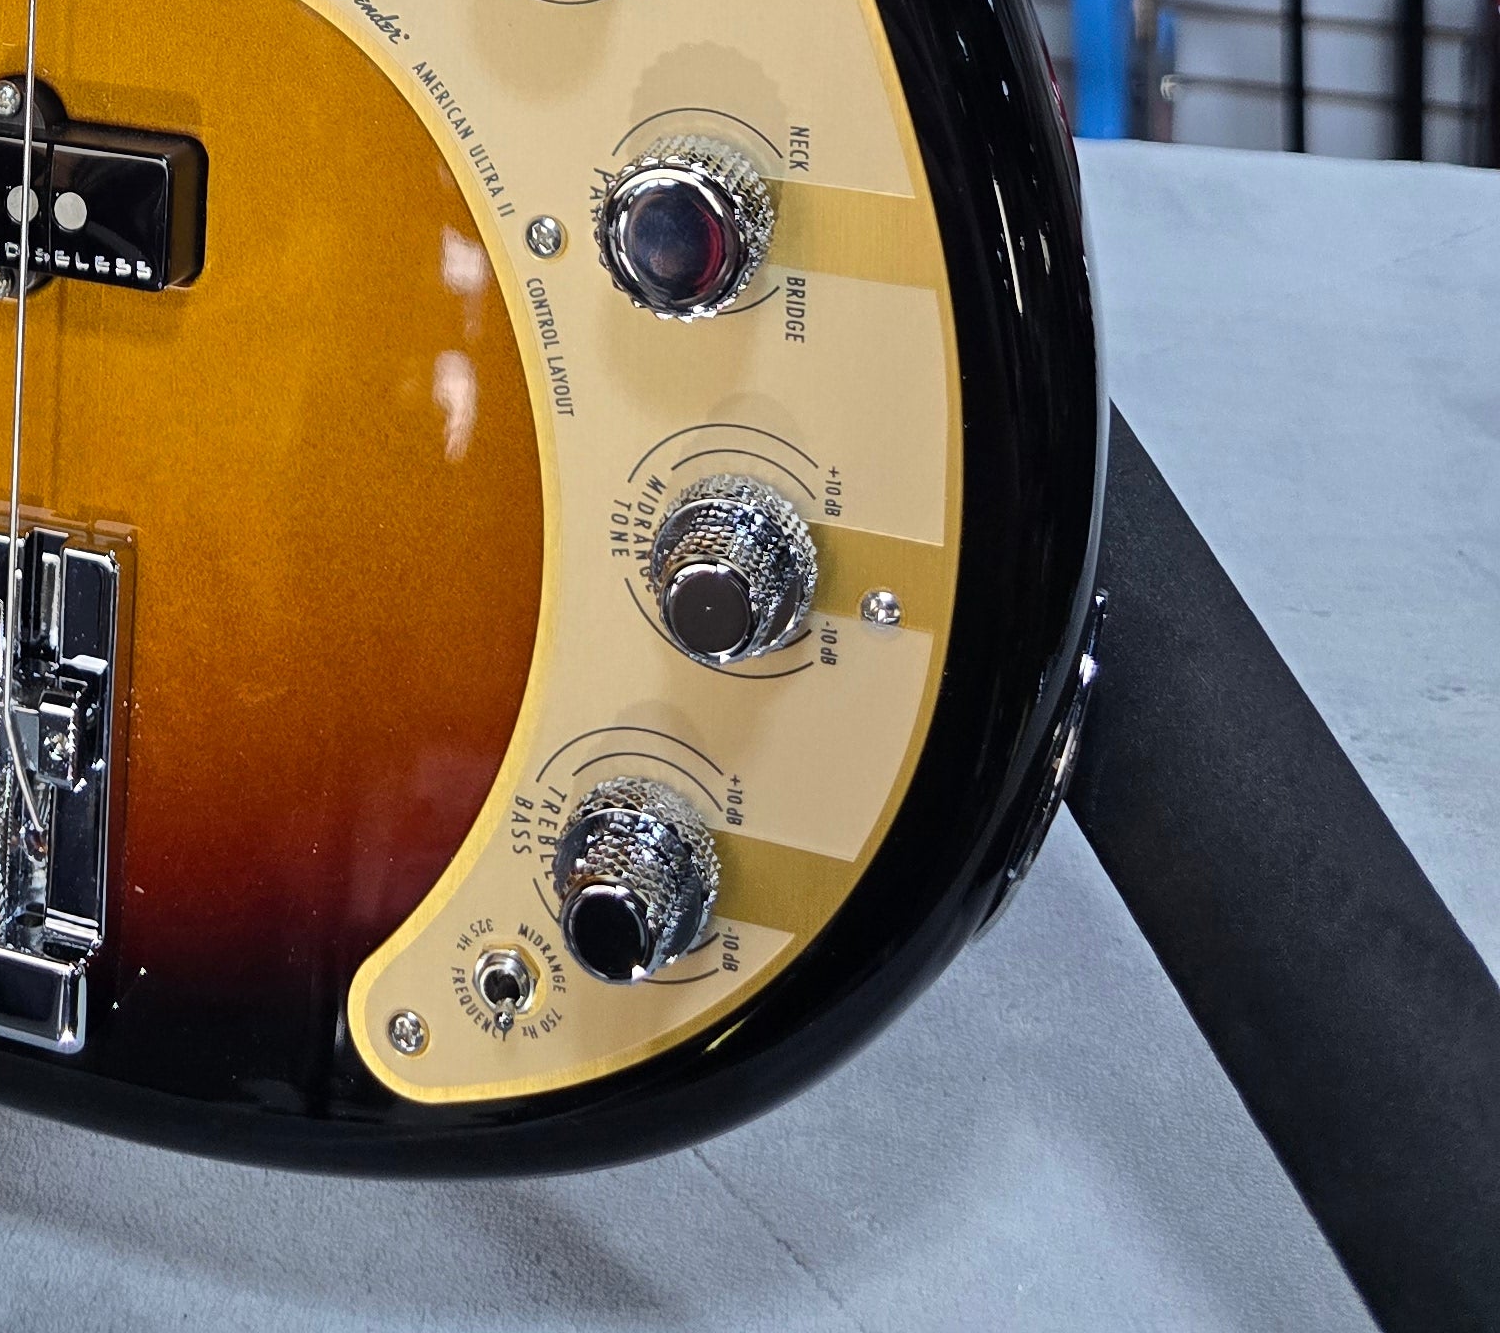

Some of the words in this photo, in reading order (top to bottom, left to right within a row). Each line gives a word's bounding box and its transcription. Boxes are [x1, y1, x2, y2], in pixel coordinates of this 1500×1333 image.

[788, 125, 810, 173] NECK
[412, 61, 475, 141] AMERICAN
[468, 143, 505, 198] ULTRA
[526, 277, 560, 350] CONTROL
[546, 354, 576, 418] LAYOUT
[785, 275, 807, 344] BRIDGE
[609, 499, 632, 558] TONE
[511, 795, 534, 855] BASS
[456, 934, 473, 951] Hz
[470, 918, 494, 937] 325
[517, 923, 567, 994] MIDRANGE
[522, 1025, 539, 1040] Hz
[539, 1008, 563, 1033] 750
